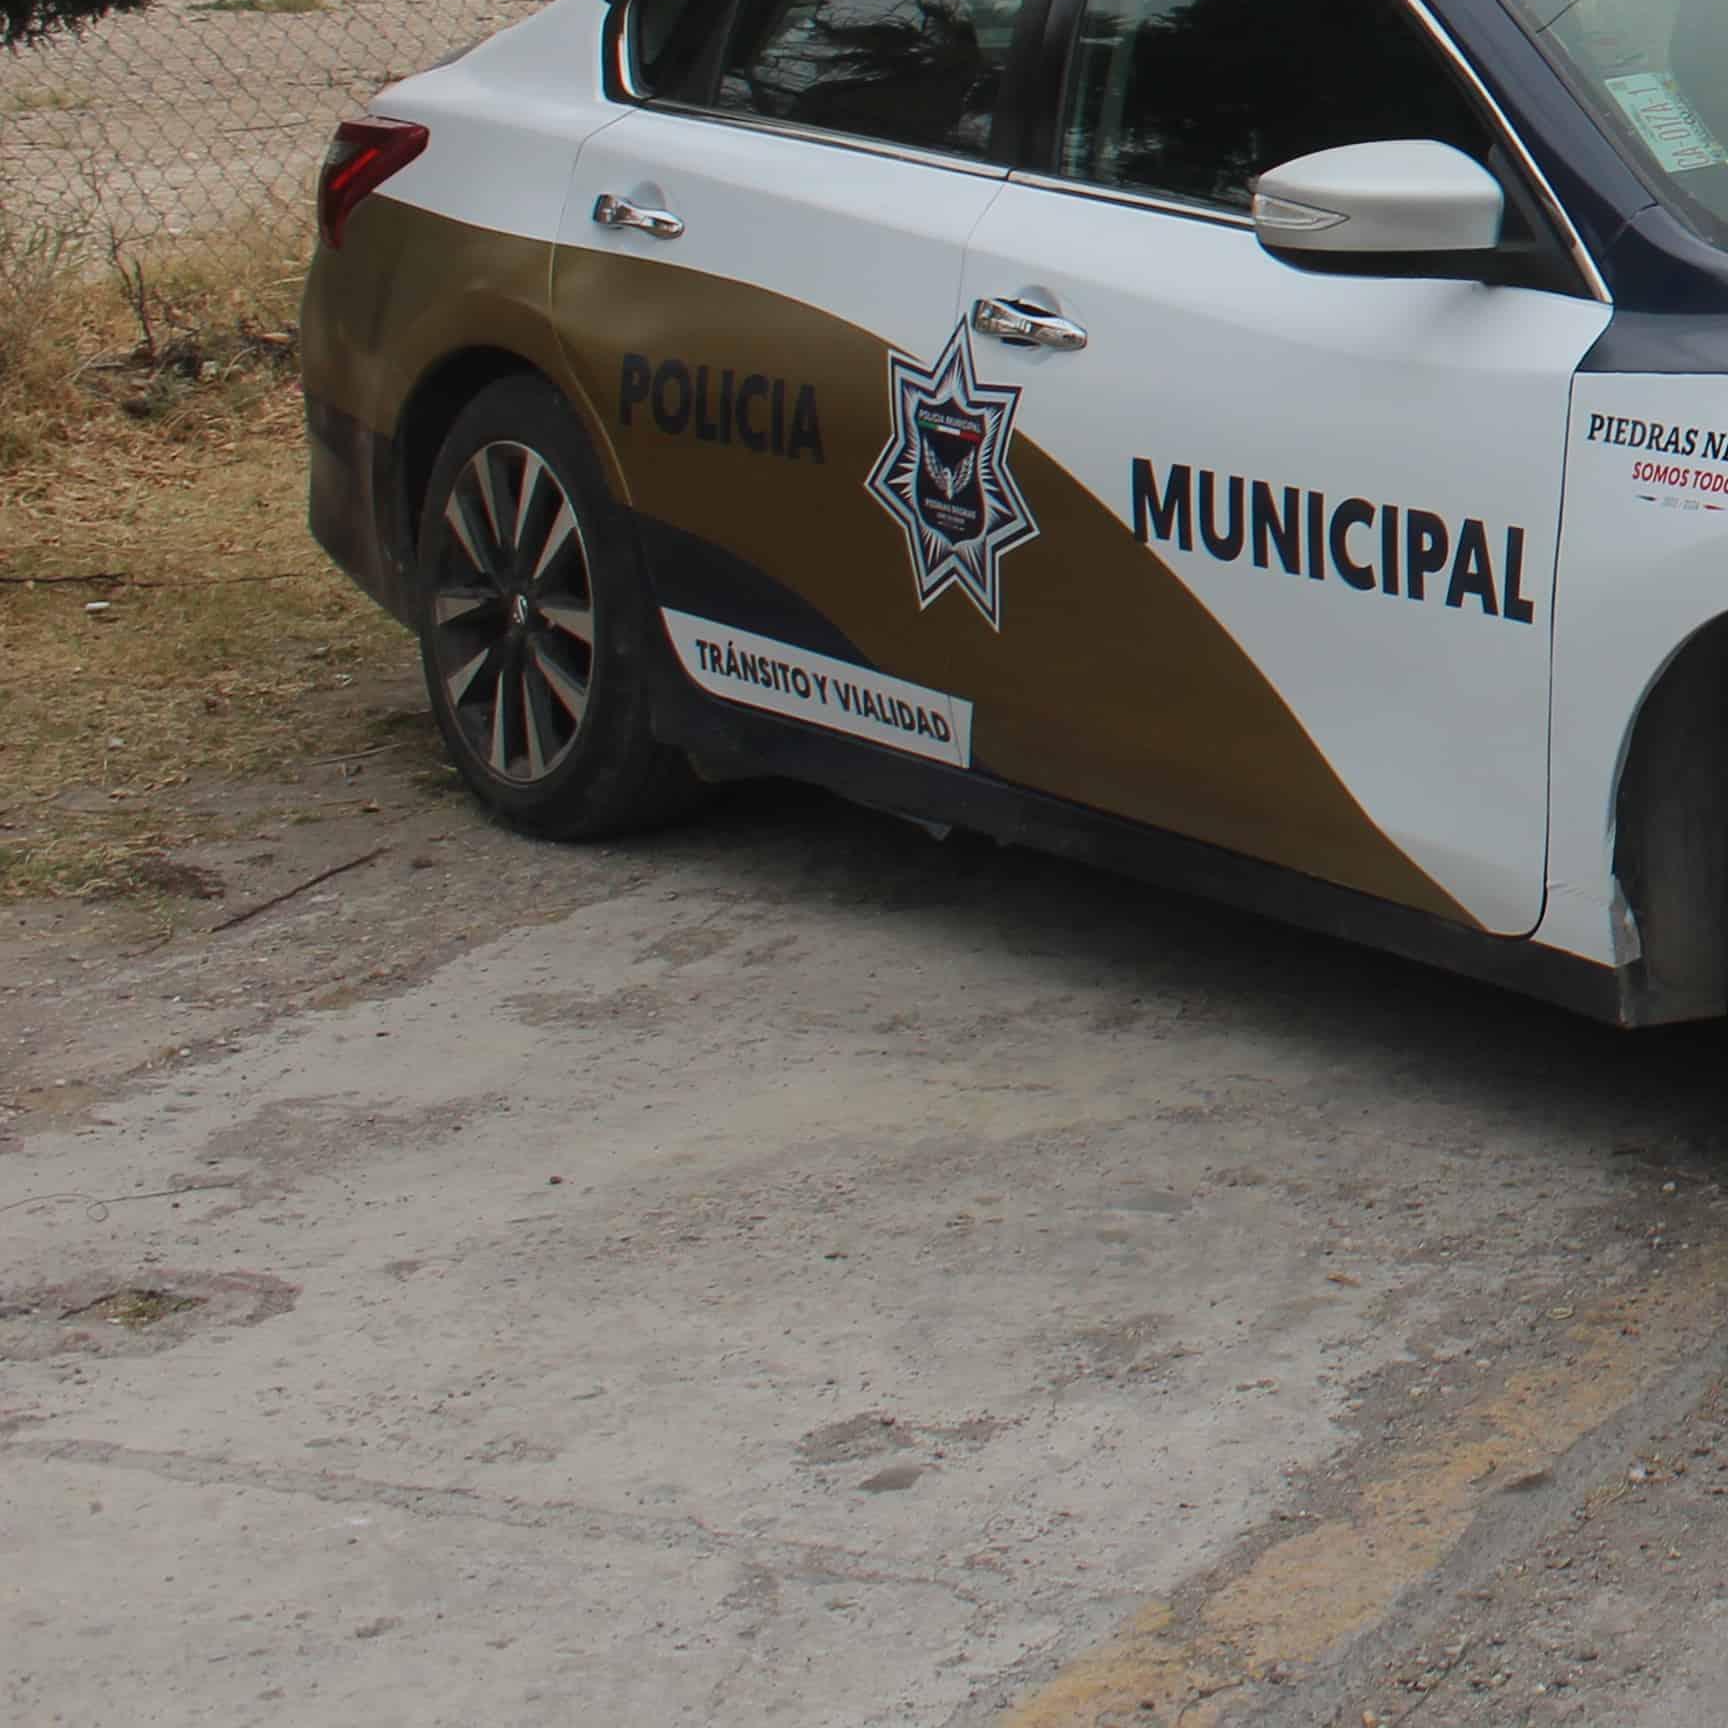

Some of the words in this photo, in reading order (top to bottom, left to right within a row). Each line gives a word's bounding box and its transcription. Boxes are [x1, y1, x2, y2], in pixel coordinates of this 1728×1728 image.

[619, 352, 825, 464] POLICIA
[1587, 413, 1699, 457] PIEDRAS
[1632, 460, 1690, 488] SOMOS
[1132, 456, 1534, 624] MUNICIPAL
[696, 639, 811, 699] TRÁNSITO
[813, 673, 829, 705] Y
[832, 680, 952, 743] VIALIDAD
